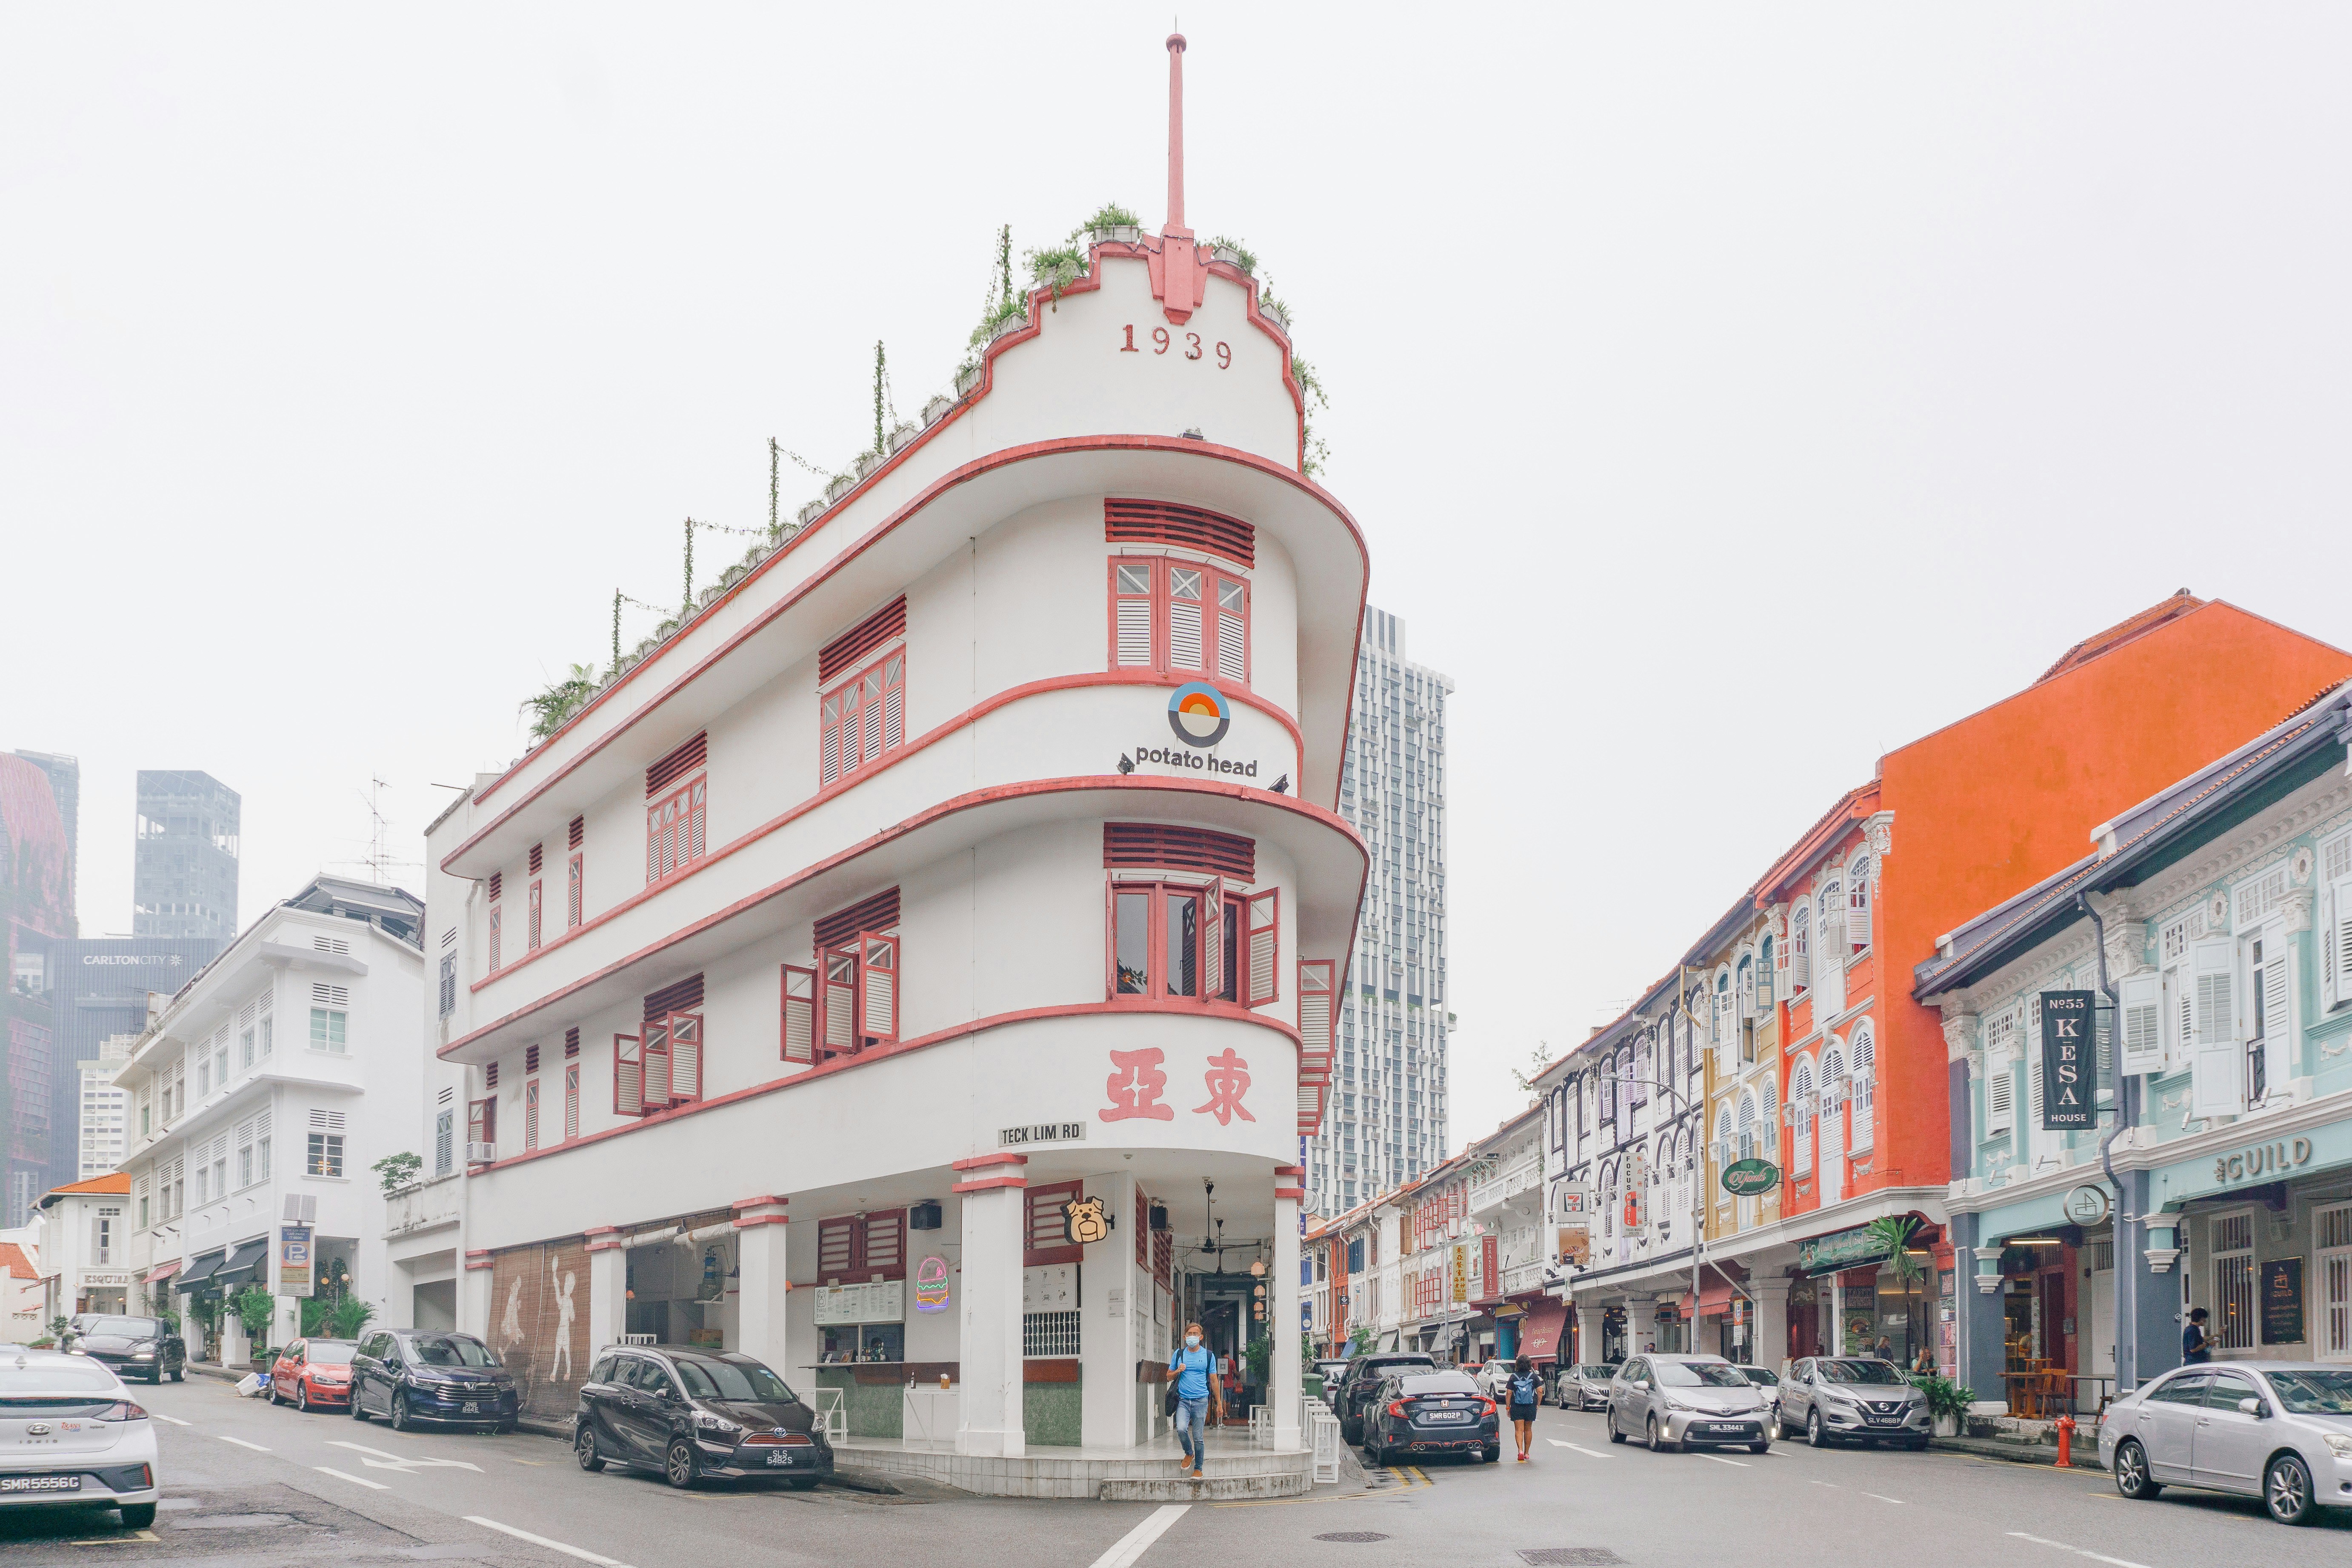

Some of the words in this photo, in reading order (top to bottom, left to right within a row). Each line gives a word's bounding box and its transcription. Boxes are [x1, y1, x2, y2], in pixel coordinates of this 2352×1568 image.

[1120, 324, 1231, 369] 1939
[1136, 747, 1203, 769] potato
[1208, 753, 1257, 777] head
[83, 955, 139, 965] CARLTON
[140, 955, 166, 965] CITY
[1003, 1128, 1029, 1143] TECK
[1034, 1125, 1057, 1141] LIM
[1063, 1123, 1080, 1139] RD
[2226, 1137, 2312, 1179] GUILD
[1768, 1173, 1777, 1188] PADANG
[1568, 1195, 1580, 1211] 7
[1455, 1246, 1464, 1276] 東亞餐室
[0, 1477, 79, 1490] SMR5556G
